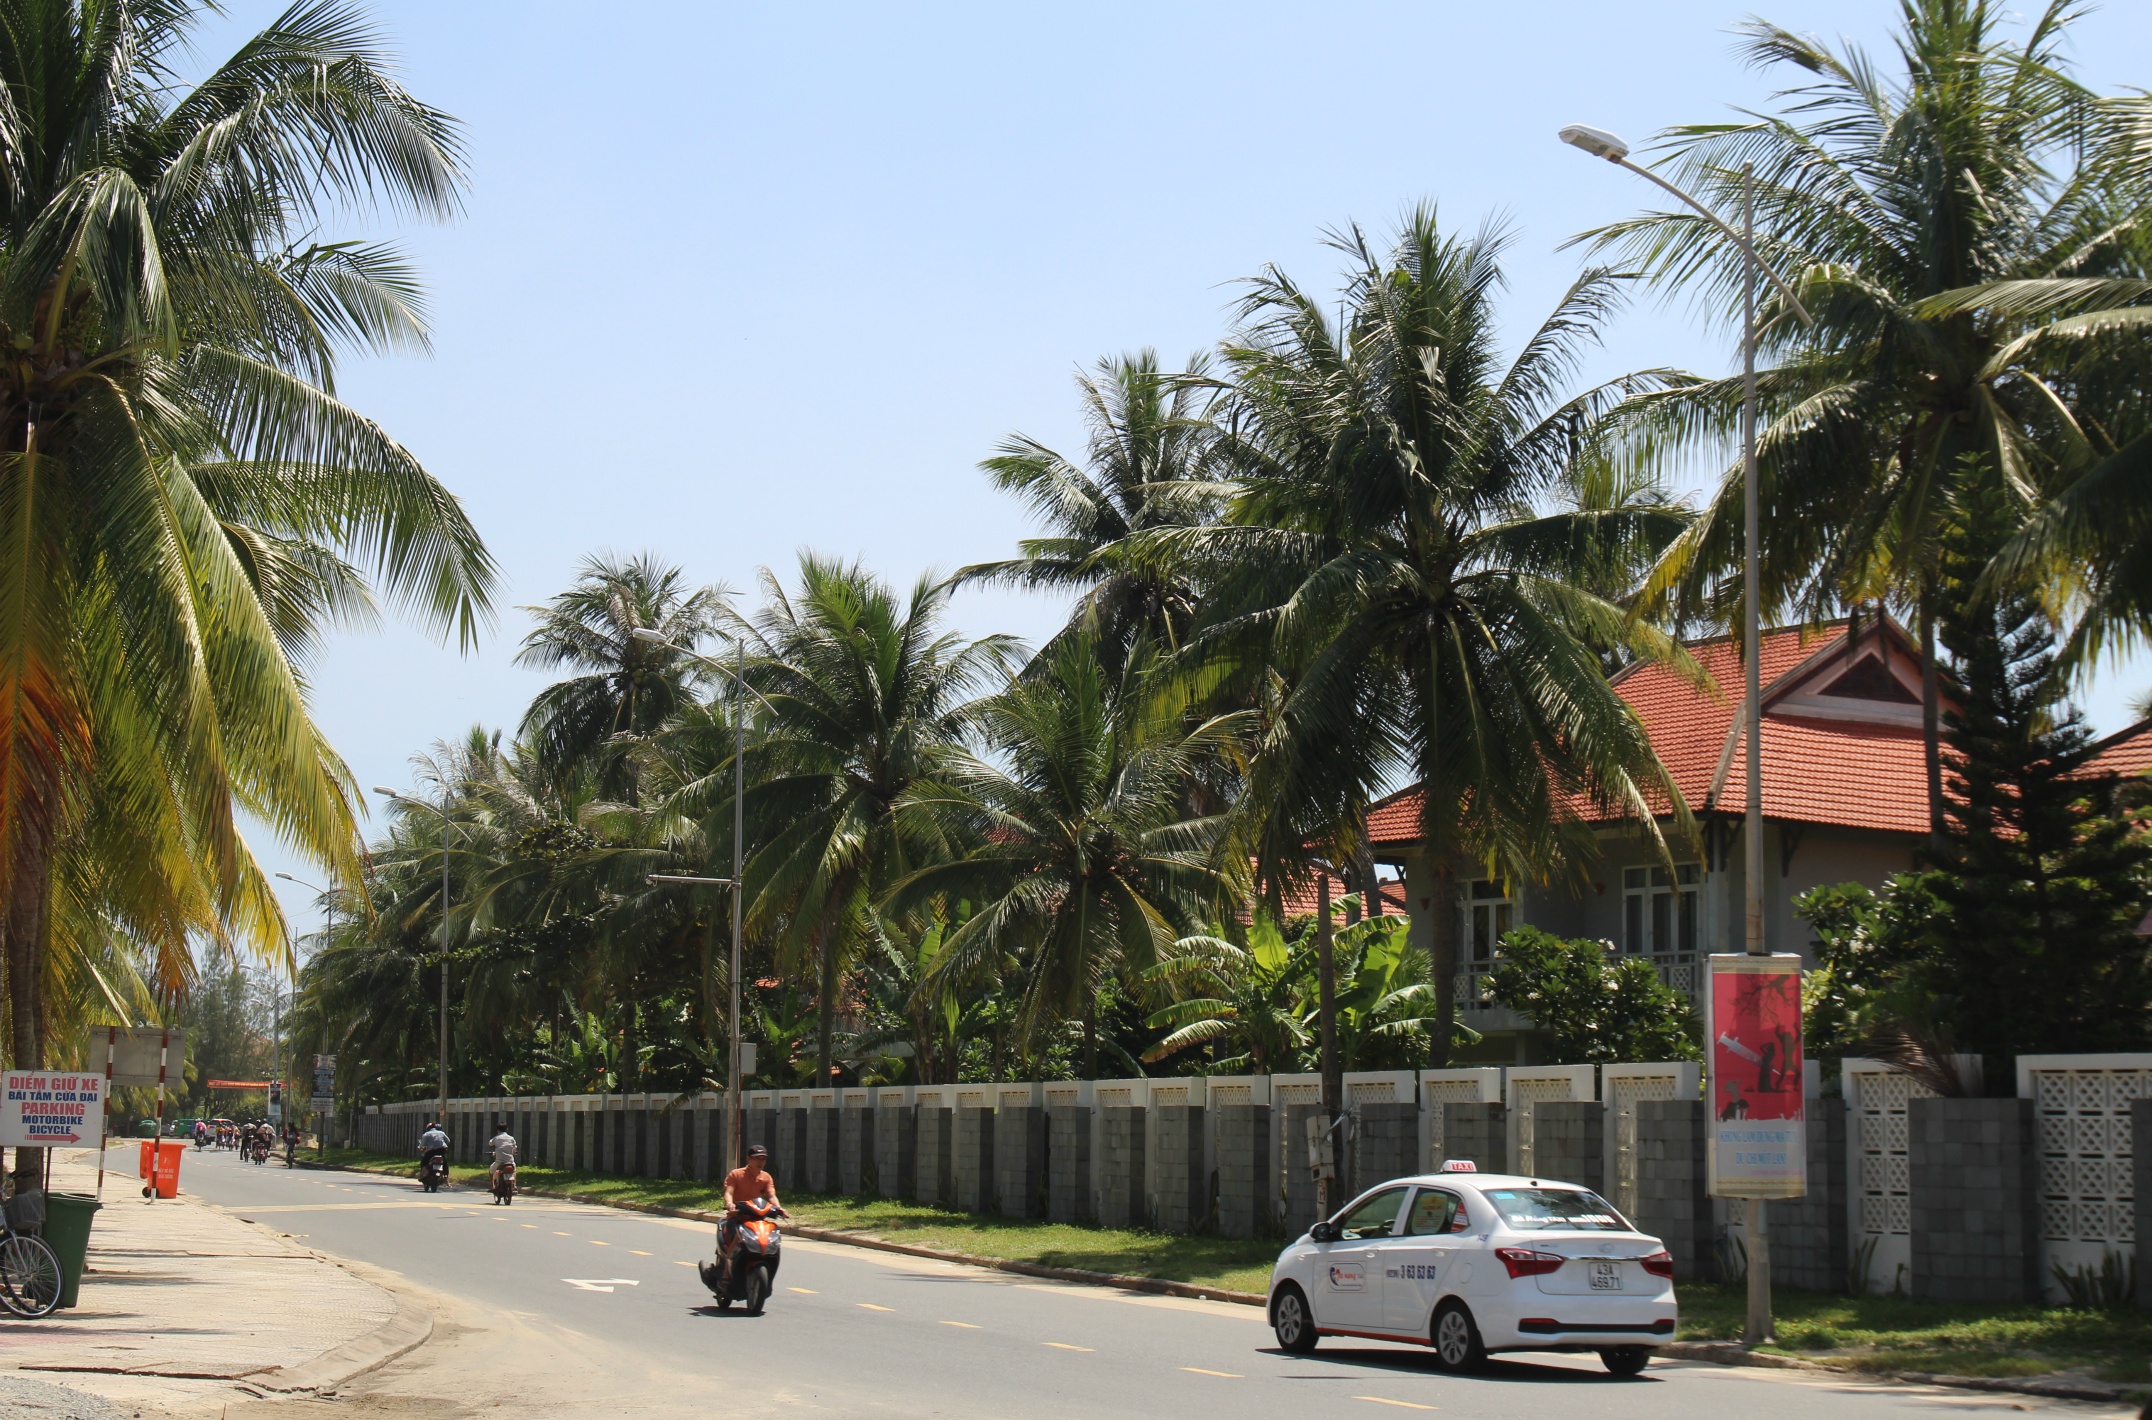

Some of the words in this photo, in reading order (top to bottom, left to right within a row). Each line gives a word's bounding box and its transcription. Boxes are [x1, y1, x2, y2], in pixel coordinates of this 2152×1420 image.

[81, 1078, 99, 1091] XE
[79, 1092, 98, 1104] ĐẠI
[21, 1102, 86, 1116] PARKING
[21, 1115, 84, 1125] MOTORBIKE
[29, 1125, 72, 1135] BICYCLE
[1451, 1162, 1474, 1171] TAXI
[1597, 1263, 1614, 1275] 43A
